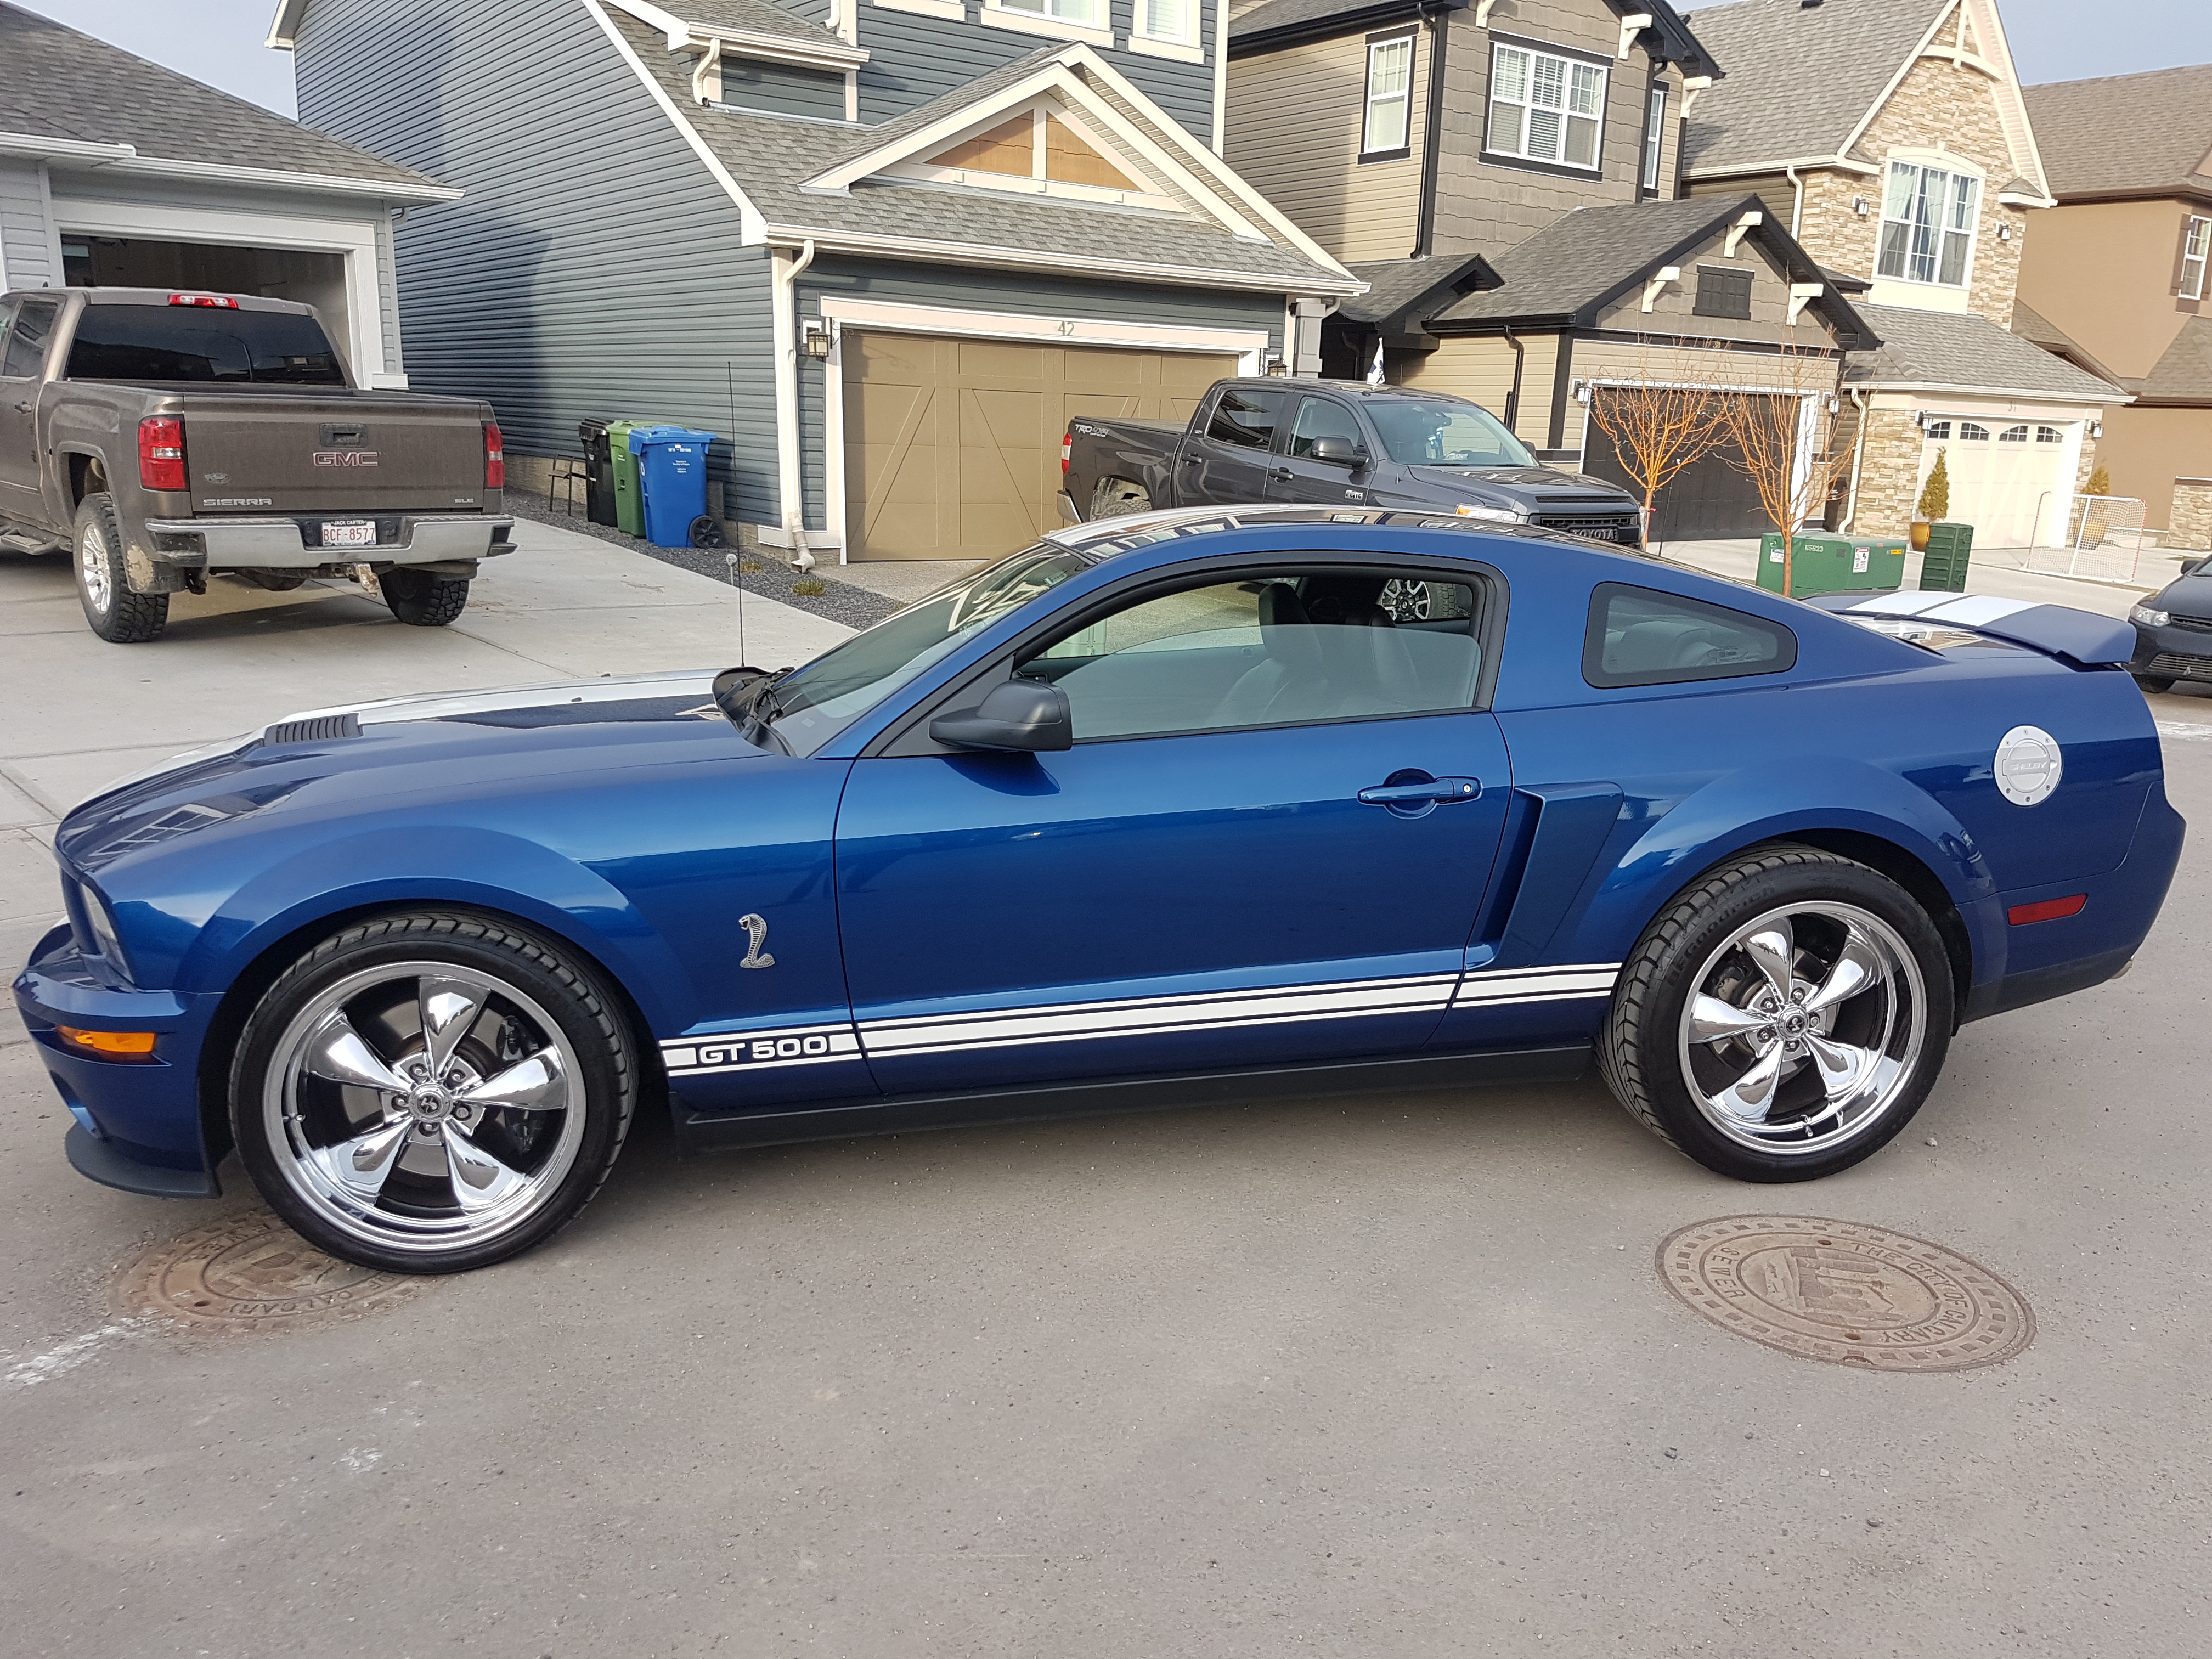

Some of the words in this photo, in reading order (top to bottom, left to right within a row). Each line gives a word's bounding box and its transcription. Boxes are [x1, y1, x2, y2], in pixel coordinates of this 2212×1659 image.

[1057, 321, 1075, 336] 42
[1075, 424, 1093, 434] TRD
[313, 452, 378, 467] GMC
[203, 498, 273, 506] SIERRA
[324, 528, 375, 541] BCF-8577
[1570, 528, 1615, 540] TOYOTA
[1805, 544, 1824, 552] 65623
[2010, 761, 2047, 771] SHELBY
[699, 1043, 746, 1064] GT
[752, 1035, 827, 1059] 500
[1850, 1242, 1903, 1261] THE
[1710, 1247, 1746, 1299] SEWER
[1906, 1262, 1957, 1288] CITY
[1943, 1292, 1968, 1308] OF
[1882, 1310, 1967, 1343] CALGARY
